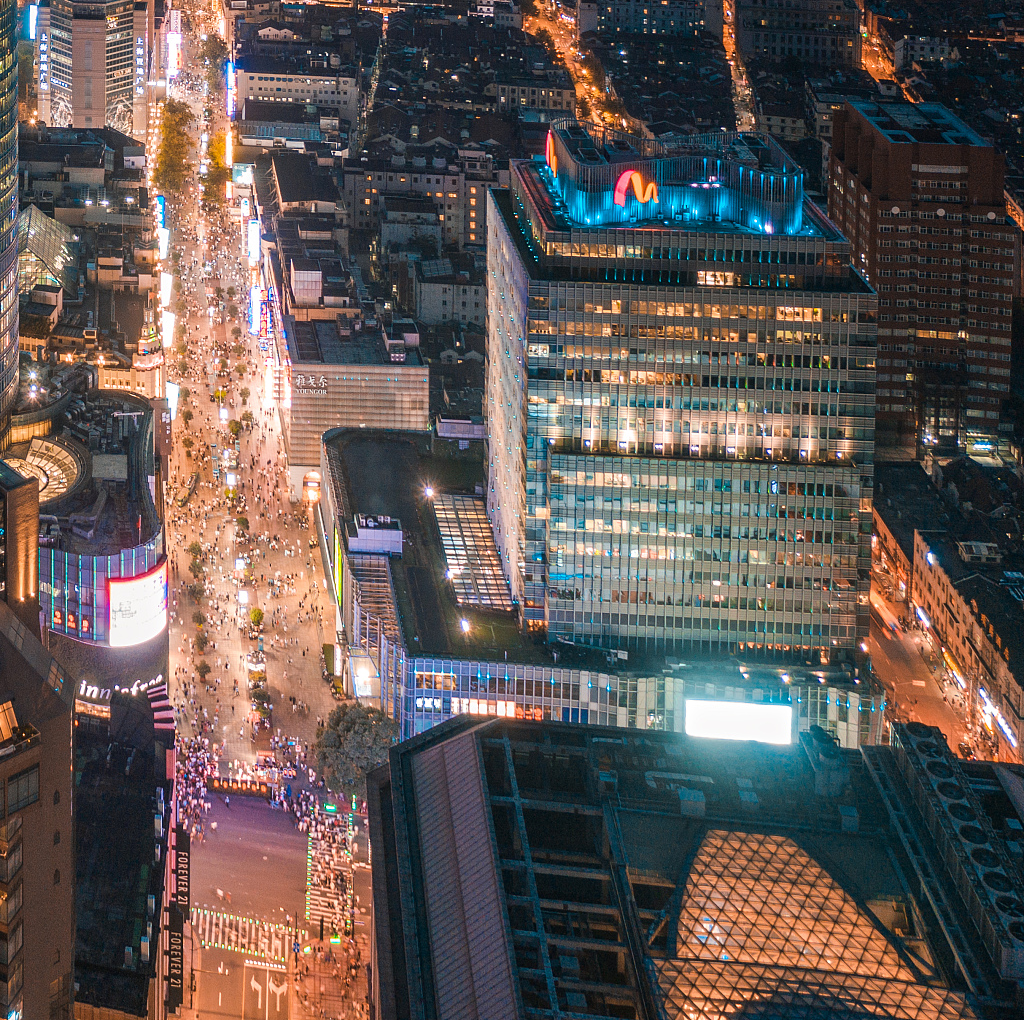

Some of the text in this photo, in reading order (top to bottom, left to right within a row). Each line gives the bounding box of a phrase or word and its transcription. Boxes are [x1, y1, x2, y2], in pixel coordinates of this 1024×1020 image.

[296, 374, 328, 388] 雅戈尔
[178, 851, 189, 905] FOREVER 21
[170, 932, 182, 988] FOREVER 21
